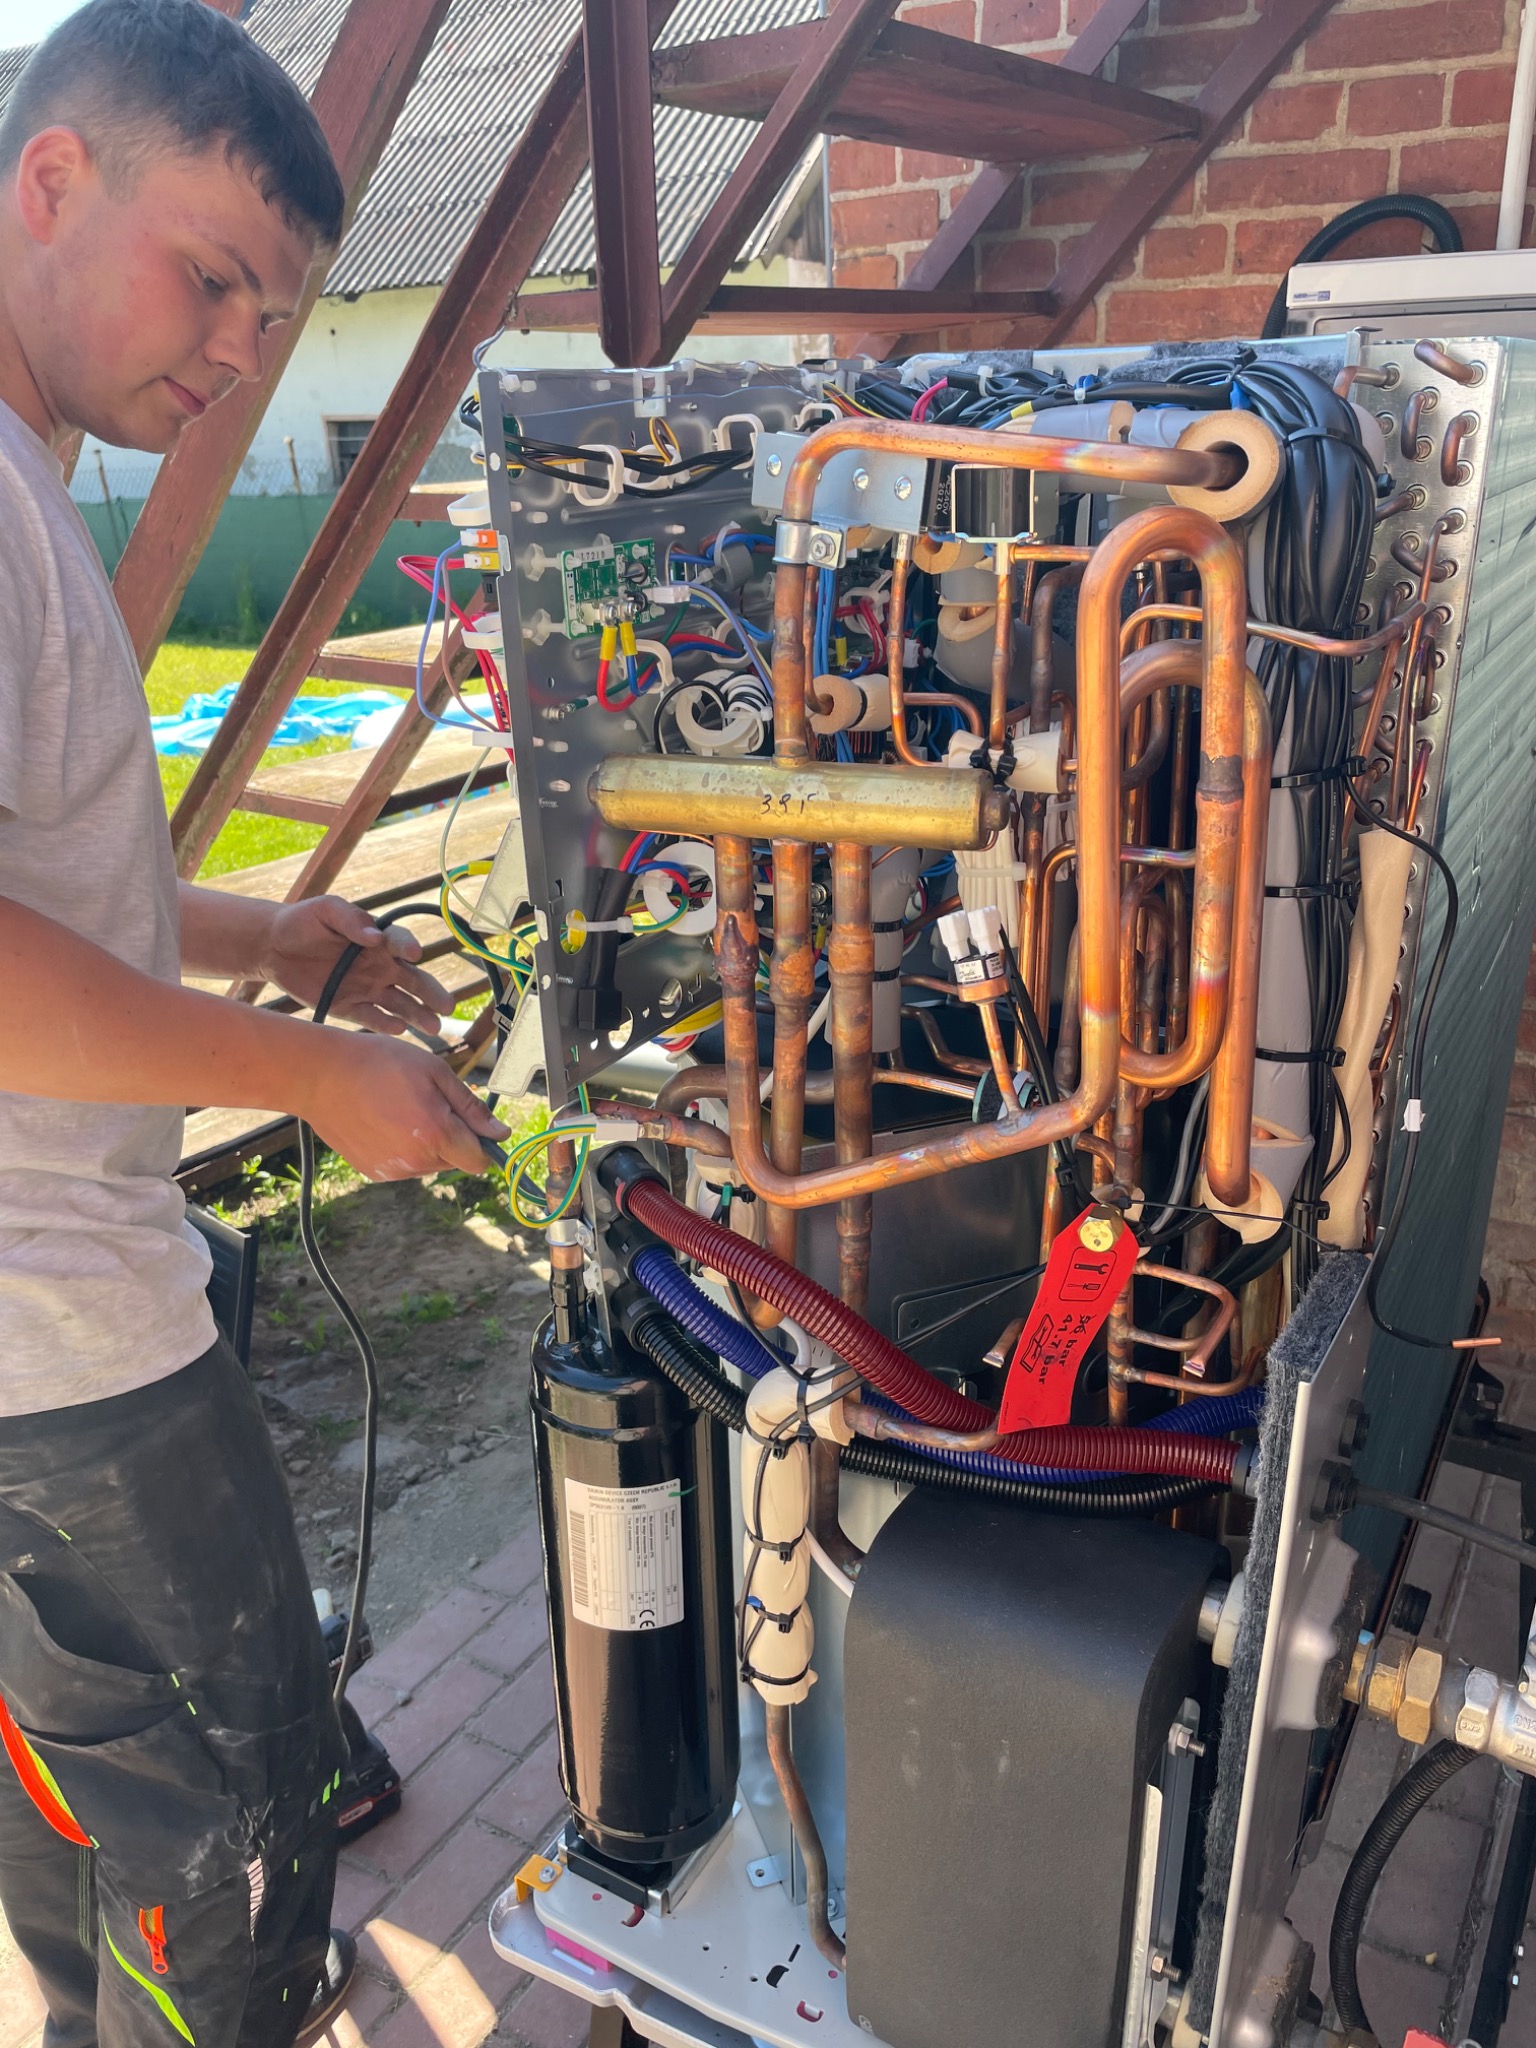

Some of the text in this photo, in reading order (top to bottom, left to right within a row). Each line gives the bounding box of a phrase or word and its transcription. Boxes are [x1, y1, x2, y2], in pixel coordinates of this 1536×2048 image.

[936, 482, 946, 510] 2070
[1058, 1338, 1077, 1367] bar
[1038, 1354, 1056, 1385] bar
[641, 1484, 665, 1494] REPUBLIC
